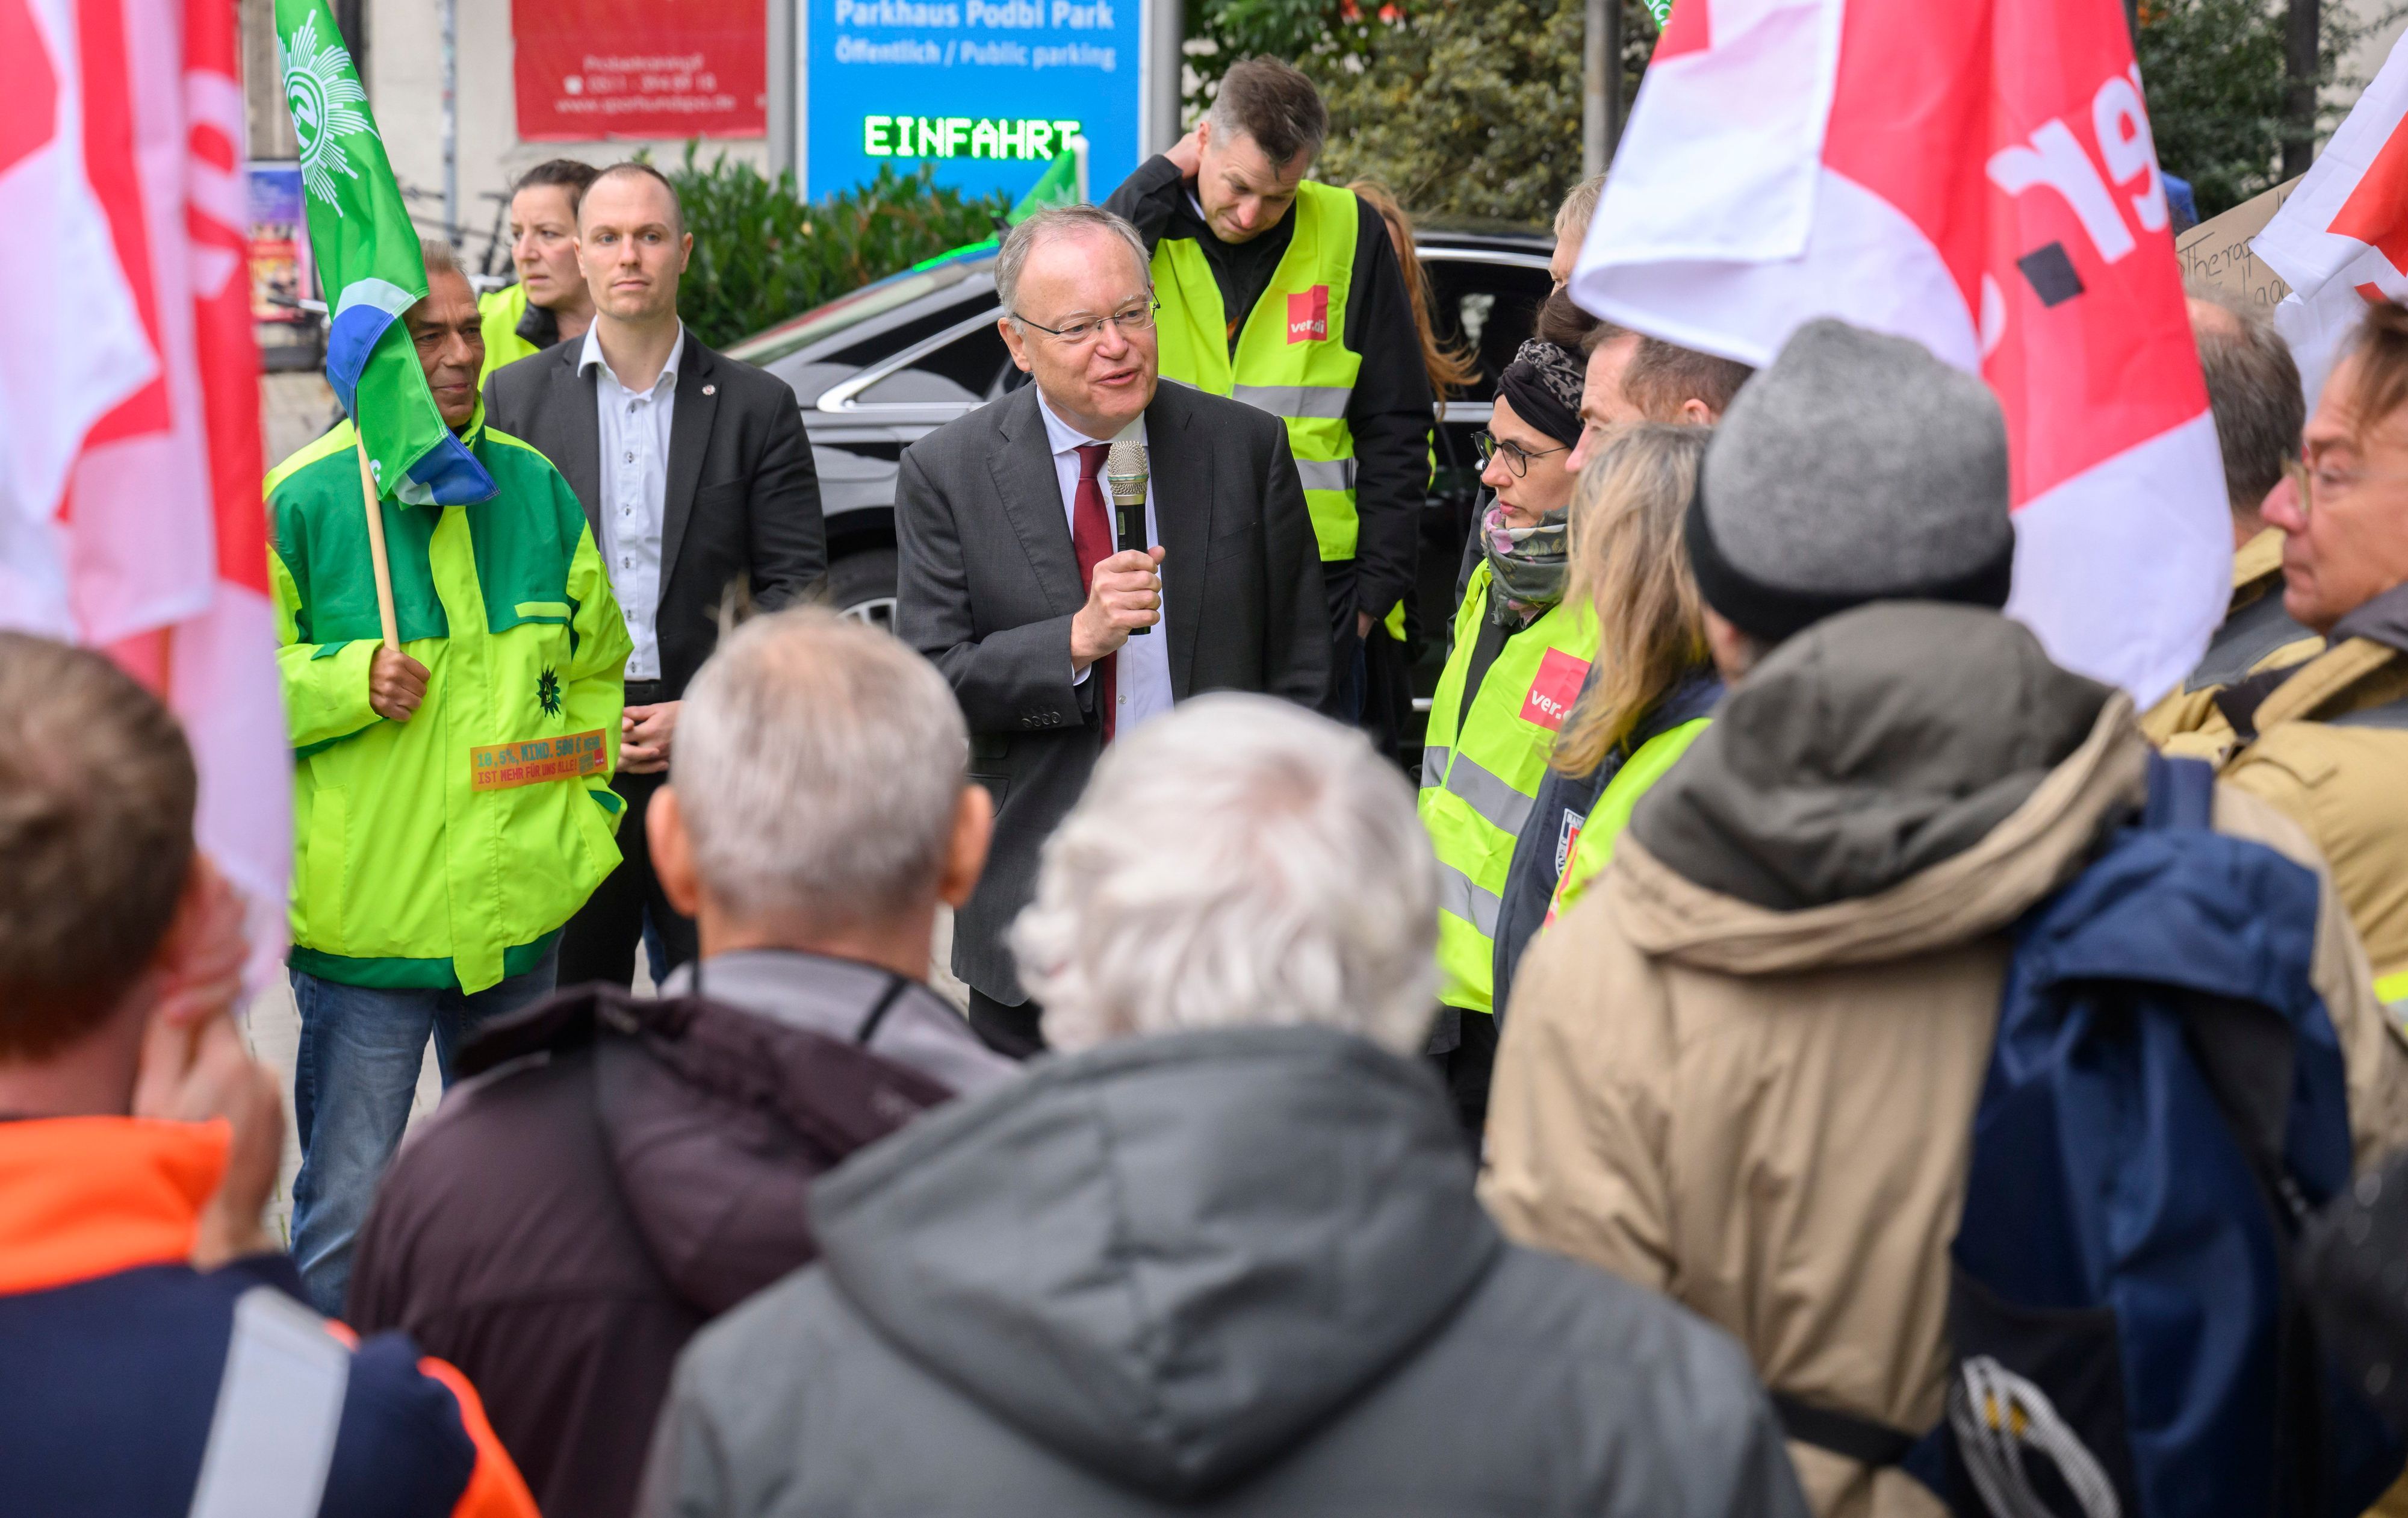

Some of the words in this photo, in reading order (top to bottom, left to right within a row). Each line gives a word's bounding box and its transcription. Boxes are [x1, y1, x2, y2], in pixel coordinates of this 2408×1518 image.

[834, 0, 960, 27] Parkhaus
[966, 0, 1046, 28] Podbi
[1051, 0, 1115, 29] Park
[834, 35, 941, 64] Öffentlich
[942, 40, 958, 68] /
[960, 41, 1029, 66] Public
[1032, 43, 1117, 72] parking
[864, 116, 1081, 161] EINFAHRT
[1290, 319, 1324, 334] ver.di
[520, 741, 554, 762] MIND.
[477, 771, 497, 785] IST
[500, 768, 524, 782] MEHR
[526, 763, 540, 779] FÜR
[542, 762, 556, 776] UNS
[557, 758, 577, 774] ALLE!
